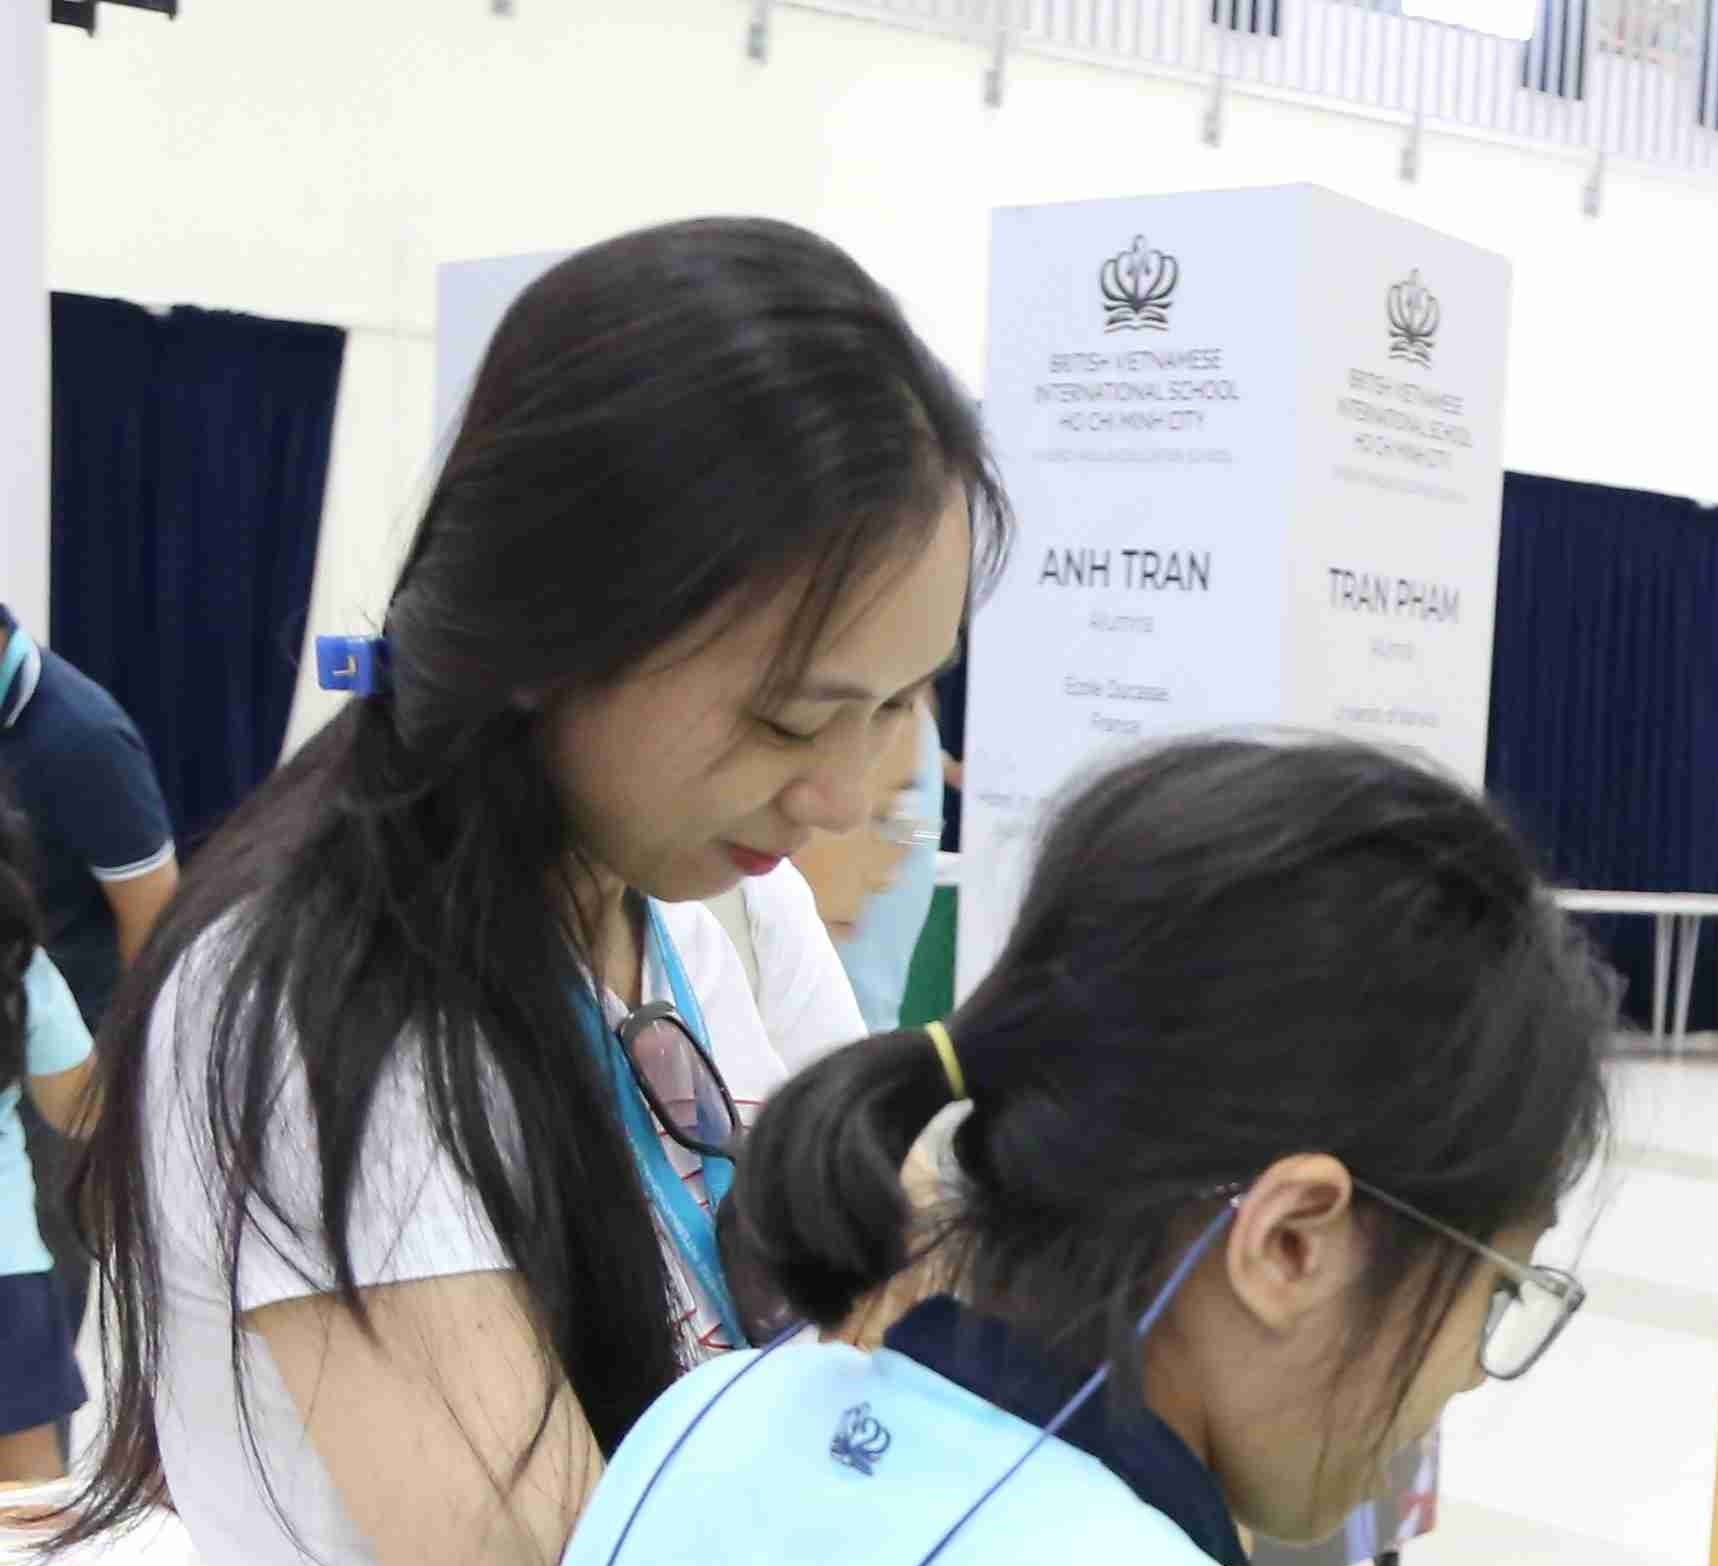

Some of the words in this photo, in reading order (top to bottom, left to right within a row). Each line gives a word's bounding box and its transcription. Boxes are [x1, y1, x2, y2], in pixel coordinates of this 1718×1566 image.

[1037, 548, 1111, 588] ANH
[1121, 548, 1211, 591] TRAN
[1329, 567, 1388, 614] TRAN
[1397, 577, 1460, 624] PHAM
